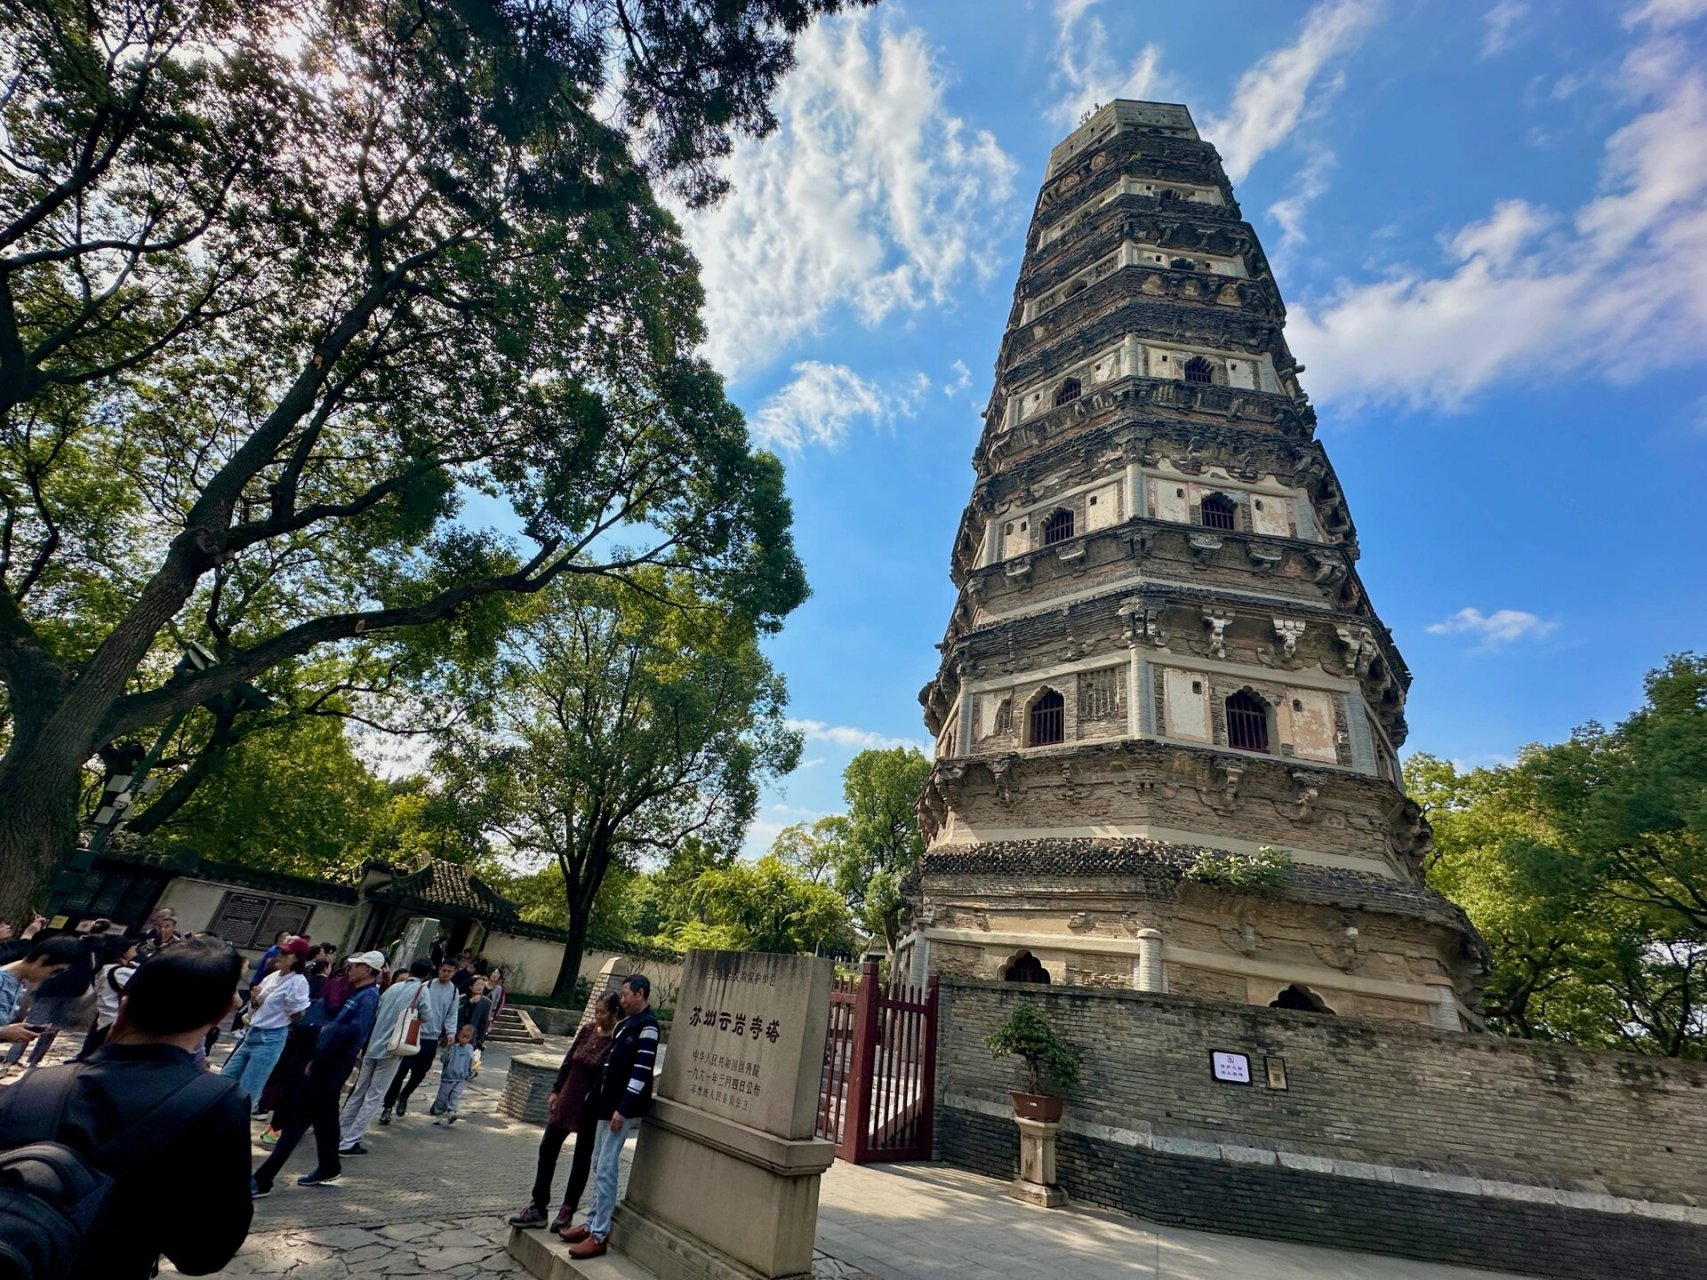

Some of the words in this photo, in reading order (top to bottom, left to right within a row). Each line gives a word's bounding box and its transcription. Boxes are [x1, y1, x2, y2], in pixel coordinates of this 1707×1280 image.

[689, 1005, 780, 1043] 苏州云岩寺塔
[693, 1049, 760, 1078] 中华人民共和国国务院
[687, 1068, 760, 1096] 一九六一年三月四日公布
